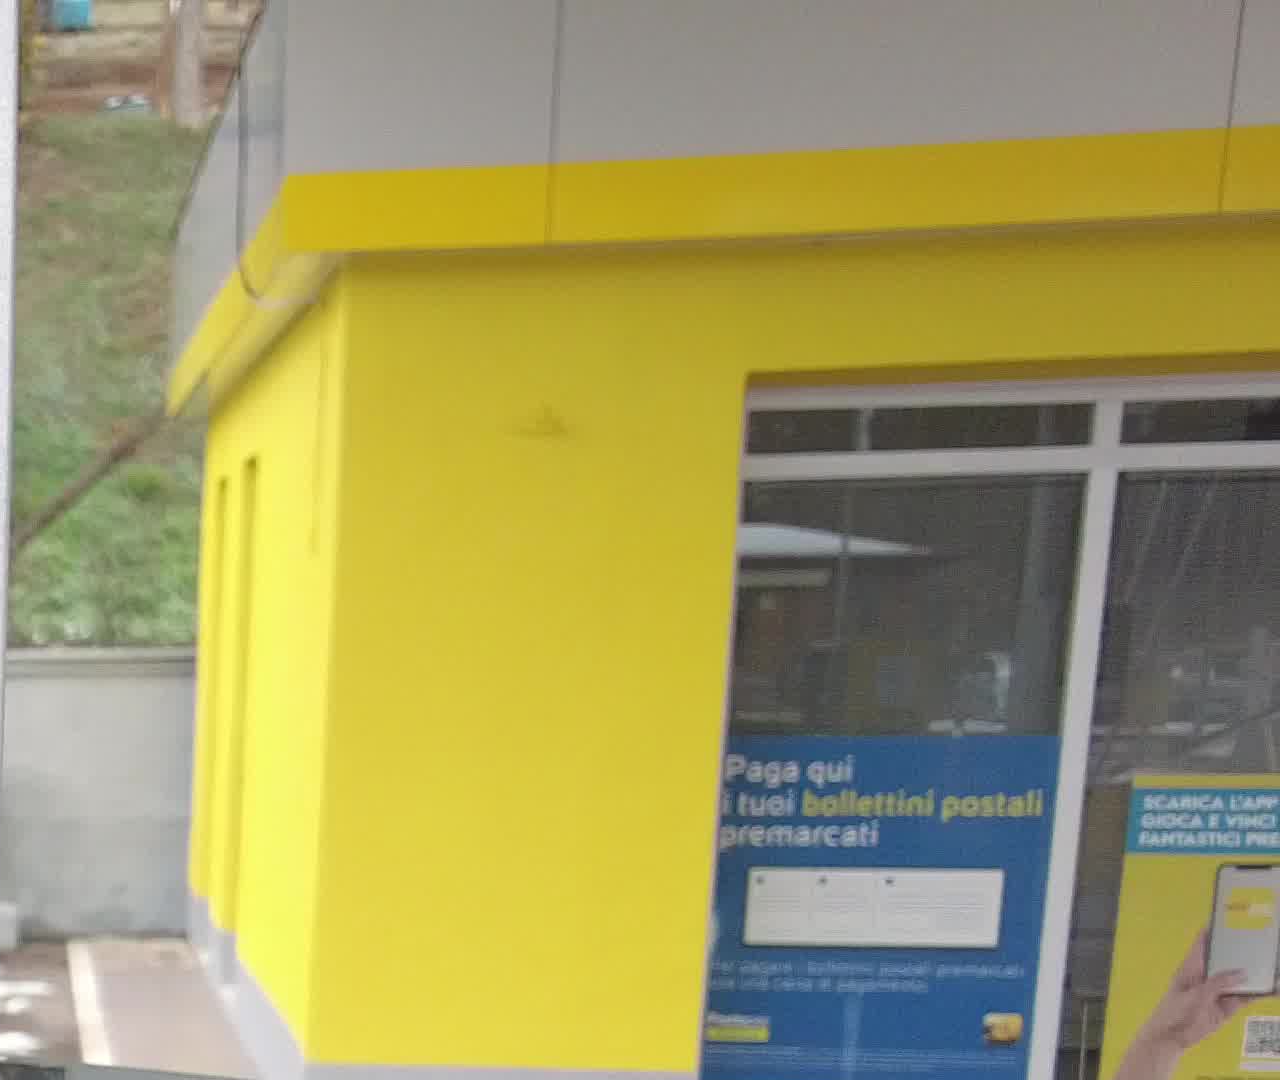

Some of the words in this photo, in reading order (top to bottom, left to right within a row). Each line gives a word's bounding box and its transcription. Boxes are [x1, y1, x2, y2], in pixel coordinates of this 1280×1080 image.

[725, 754, 800, 789] Paga
[807, 754, 855, 789] qui
[738, 789, 796, 817] tuoi
[802, 788, 935, 817] bollettini
[942, 788, 1043, 822] postali
[1143, 794, 1224, 811] SCARICA
[1141, 812, 1202, 829] GIOCA
[1225, 813, 1276, 829] VINCI
[719, 818, 881, 848] premarcati
[1138, 831, 1240, 848] FANTASTICI
